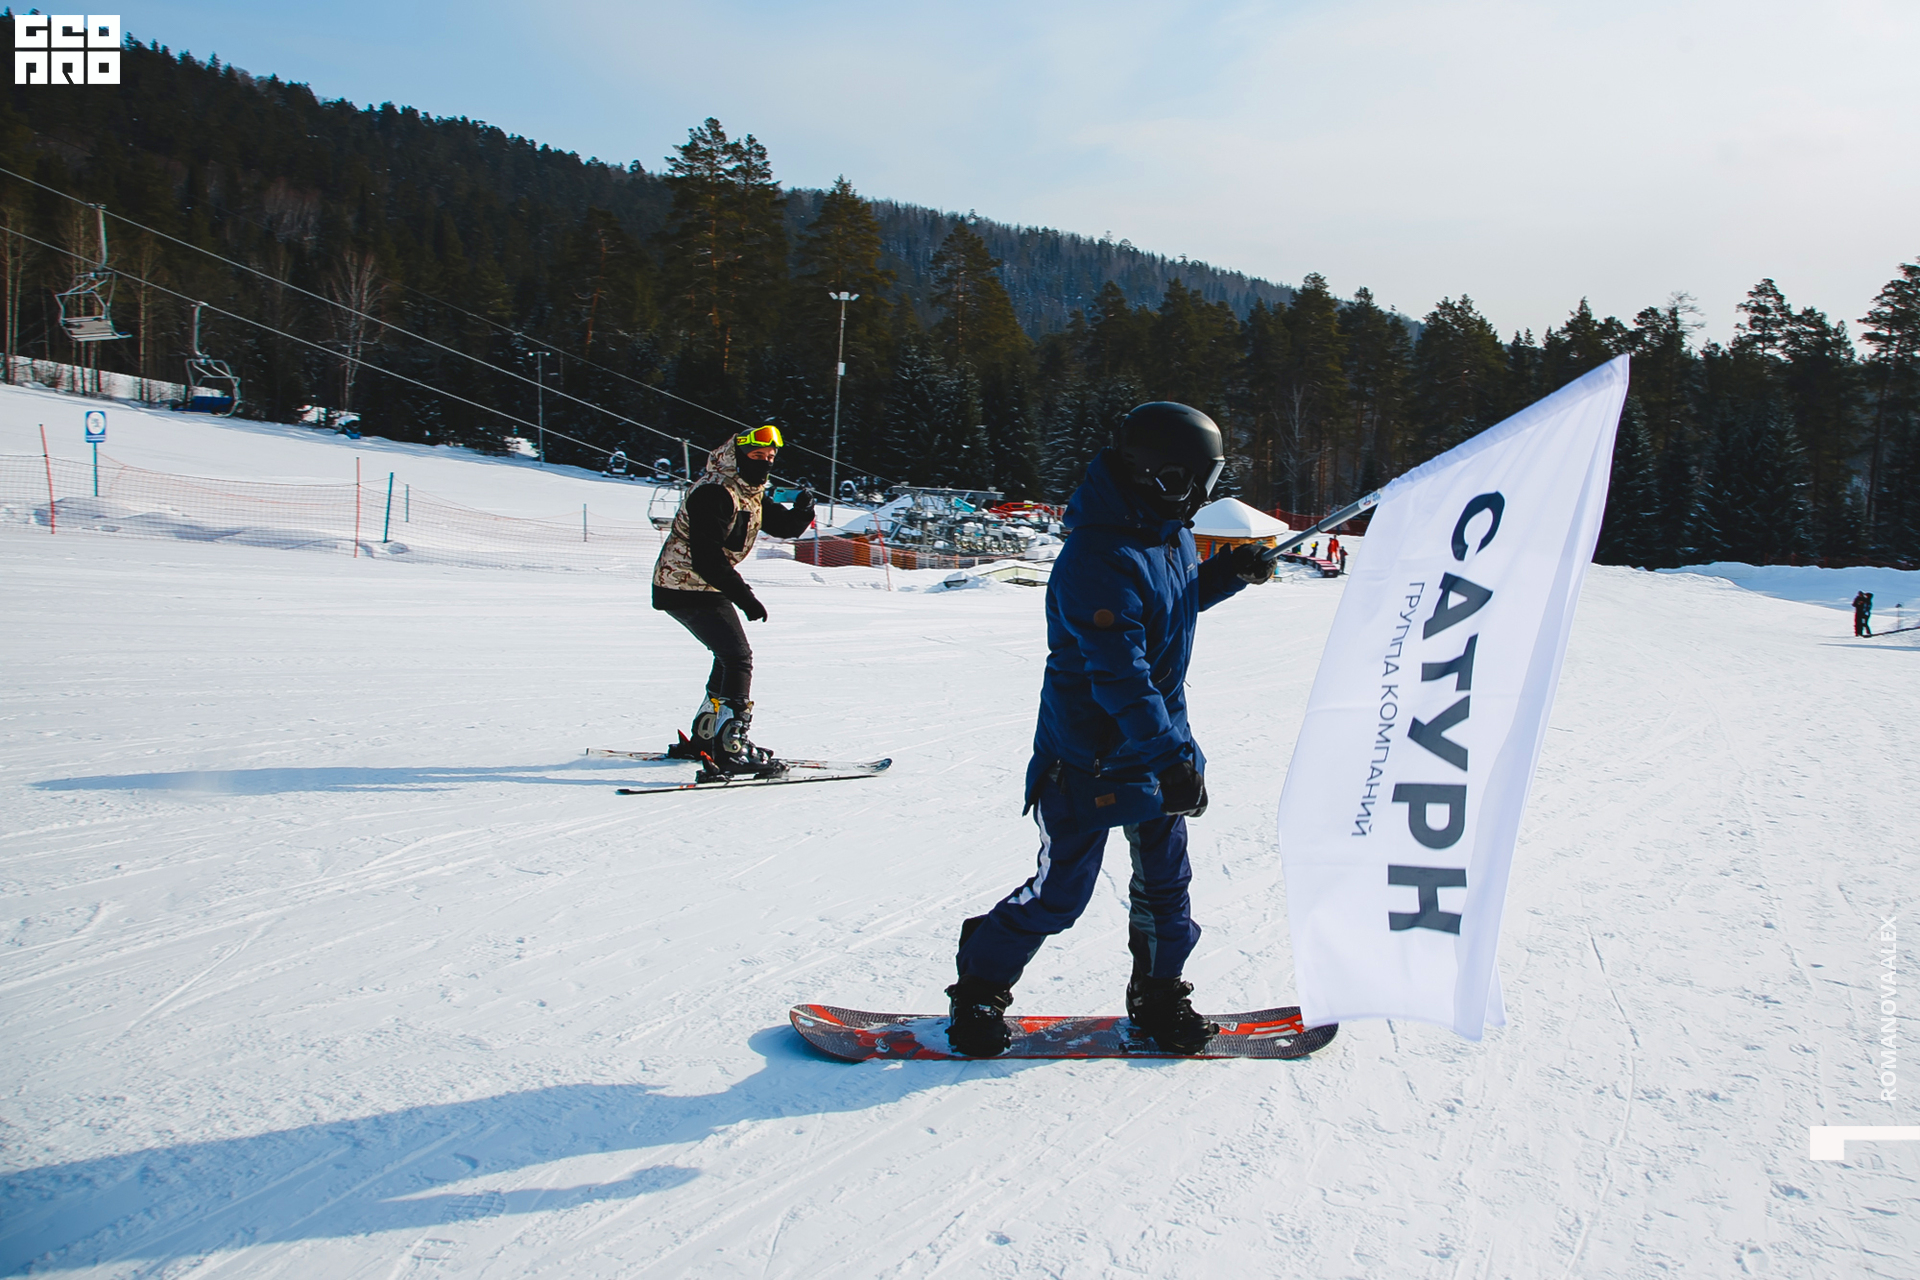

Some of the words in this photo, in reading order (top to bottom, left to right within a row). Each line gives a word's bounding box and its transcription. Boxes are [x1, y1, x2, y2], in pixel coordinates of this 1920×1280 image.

[1381, 581, 1426, 679] ГРУППА
[1350, 684, 1399, 837] КОМПАНИЙ
[1387, 490, 1506, 937] САТУРН
